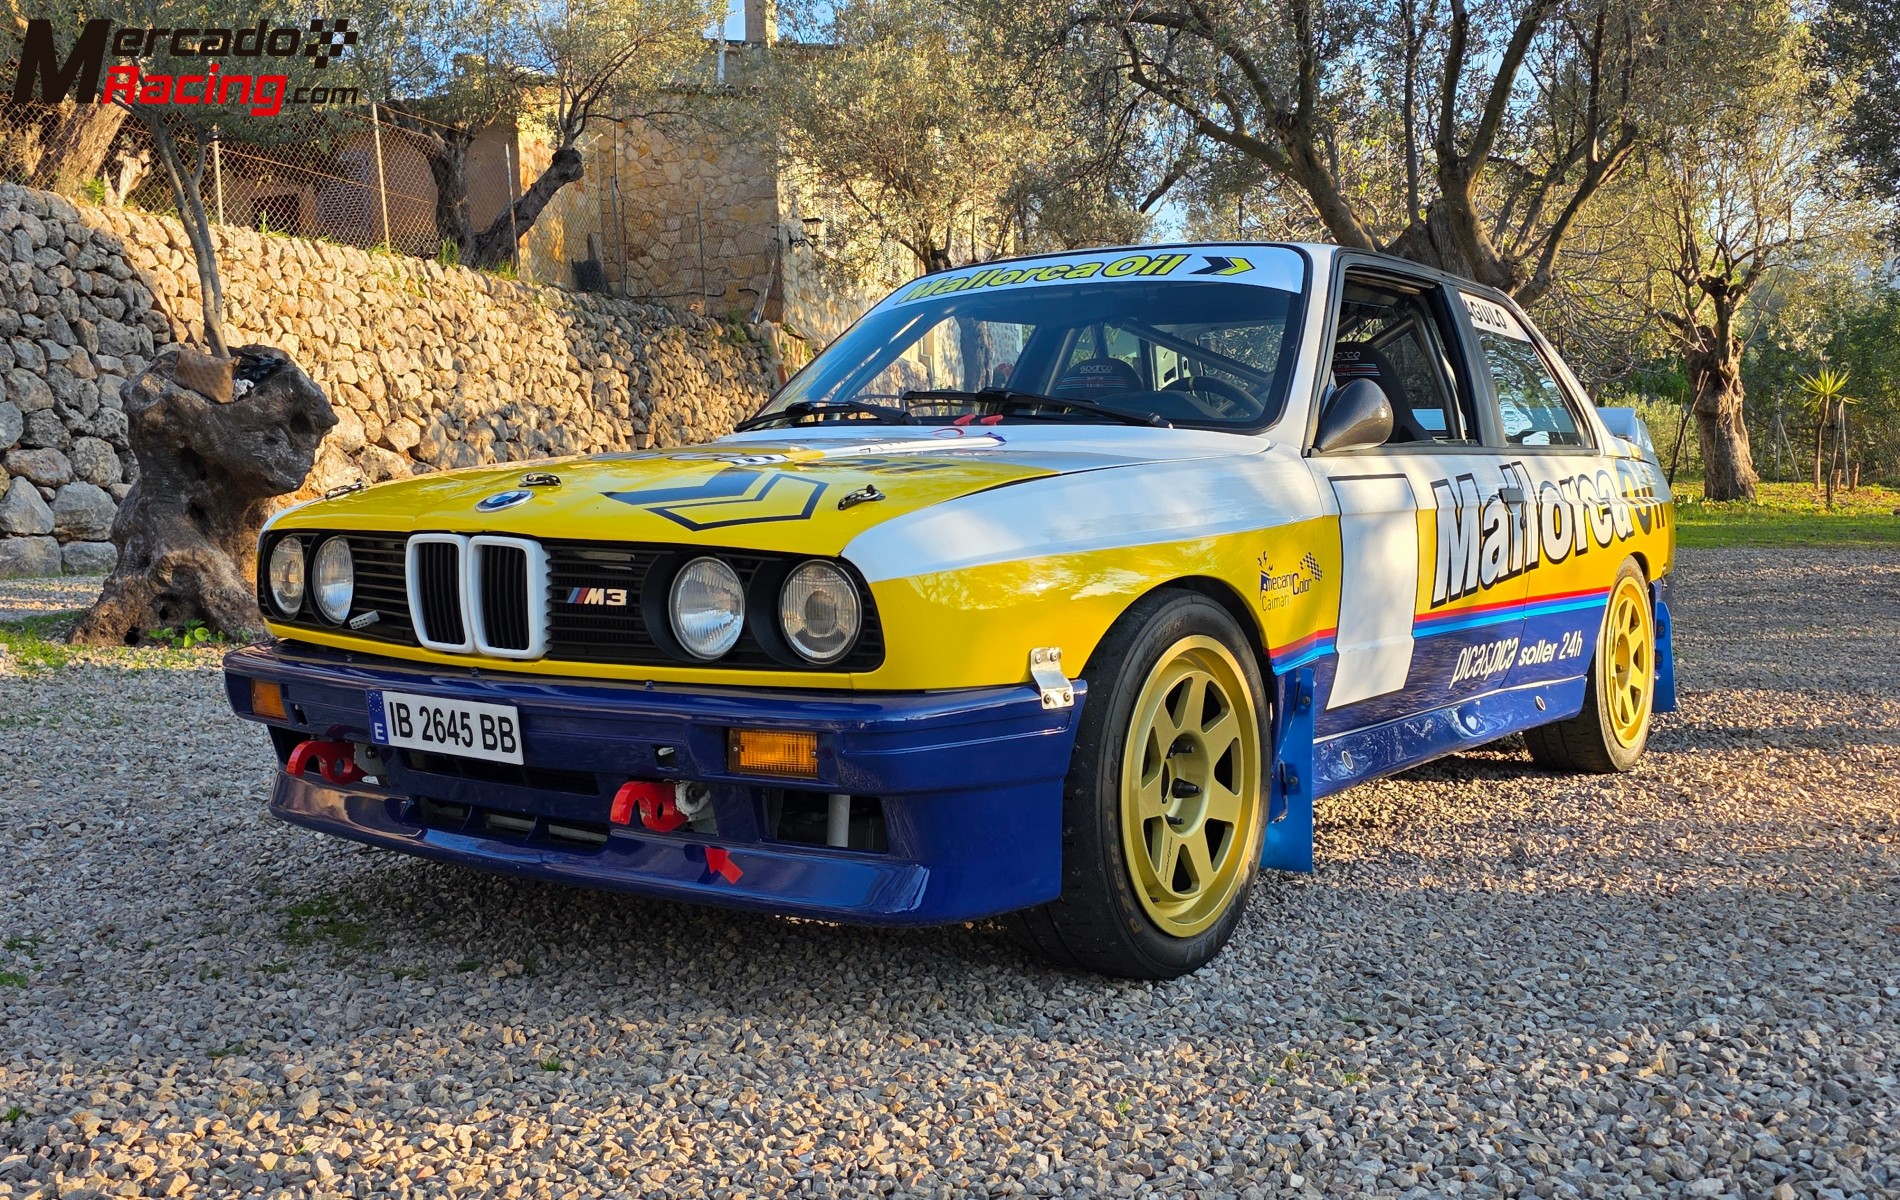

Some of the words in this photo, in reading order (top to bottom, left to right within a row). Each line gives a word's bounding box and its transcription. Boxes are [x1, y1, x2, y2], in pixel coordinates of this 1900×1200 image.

[1430, 461, 1636, 609] Mallorca
[583, 588, 628, 606] M3
[1518, 640, 1558, 666] soller
[1559, 630, 1583, 659] 24h
[374, 722, 386, 741] E
[389, 702, 414, 738] IB
[419, 705, 474, 748] 2645
[480, 714, 517, 753] BB
